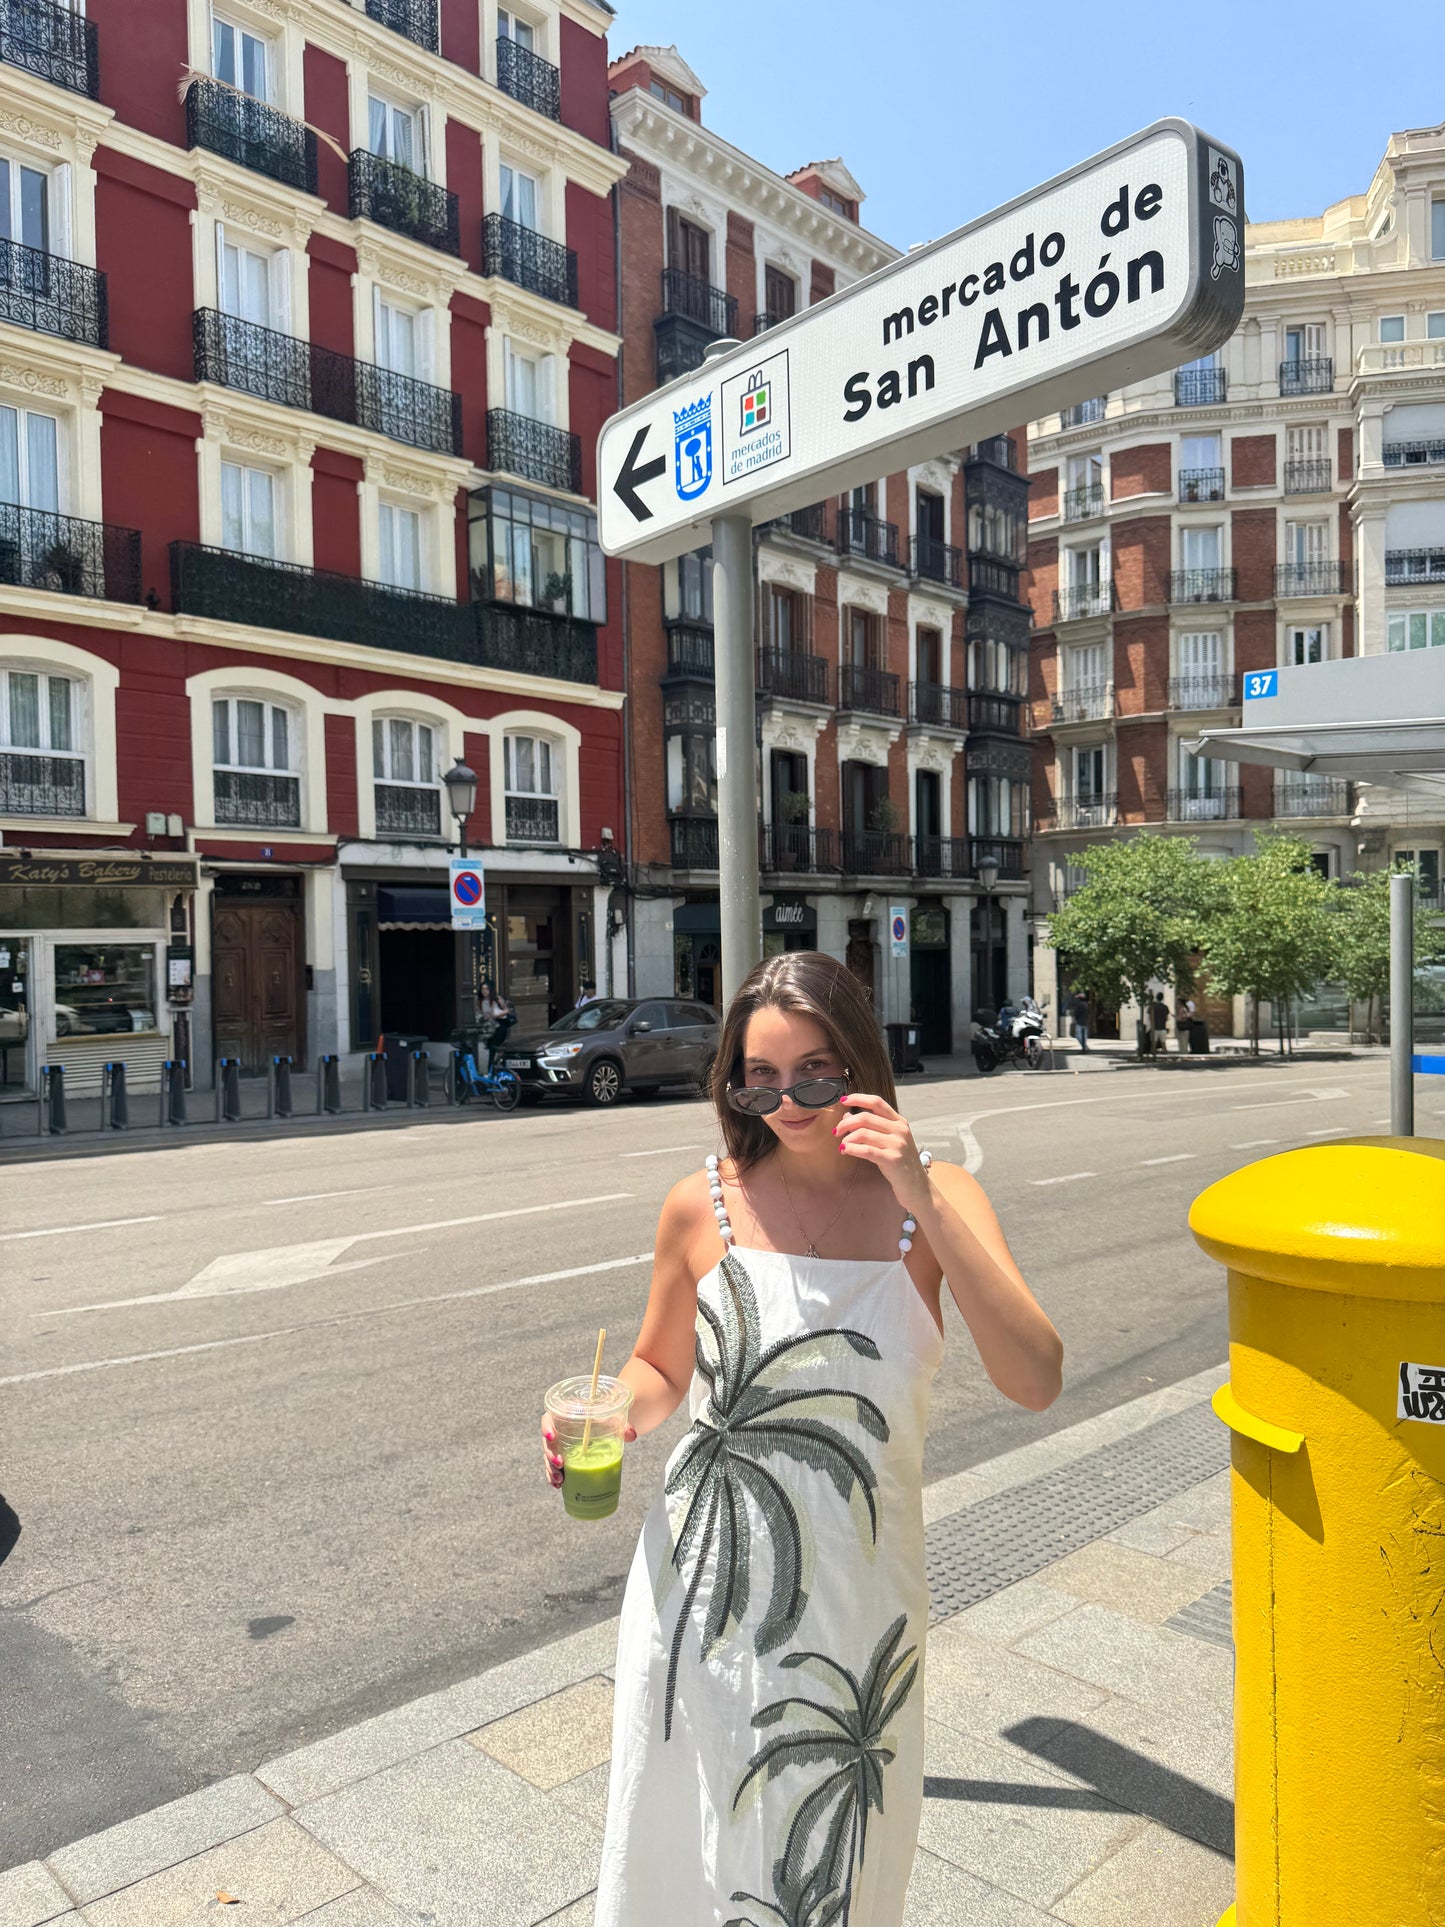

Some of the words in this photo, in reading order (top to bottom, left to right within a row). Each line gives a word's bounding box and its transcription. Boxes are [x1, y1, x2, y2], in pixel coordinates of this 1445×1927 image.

[883, 233, 1066, 346] mercado
[1101, 183, 1163, 238] de
[844, 355, 934, 422] San
[974, 251, 1164, 370] Antón
[731, 430, 781, 460] mercados
[731, 461, 743, 475] de
[747, 441, 782, 469] madrid
[1250, 675, 1272, 696] 37
[8, 864, 69, 883] Katy's
[78, 861, 142, 883] Bakery
